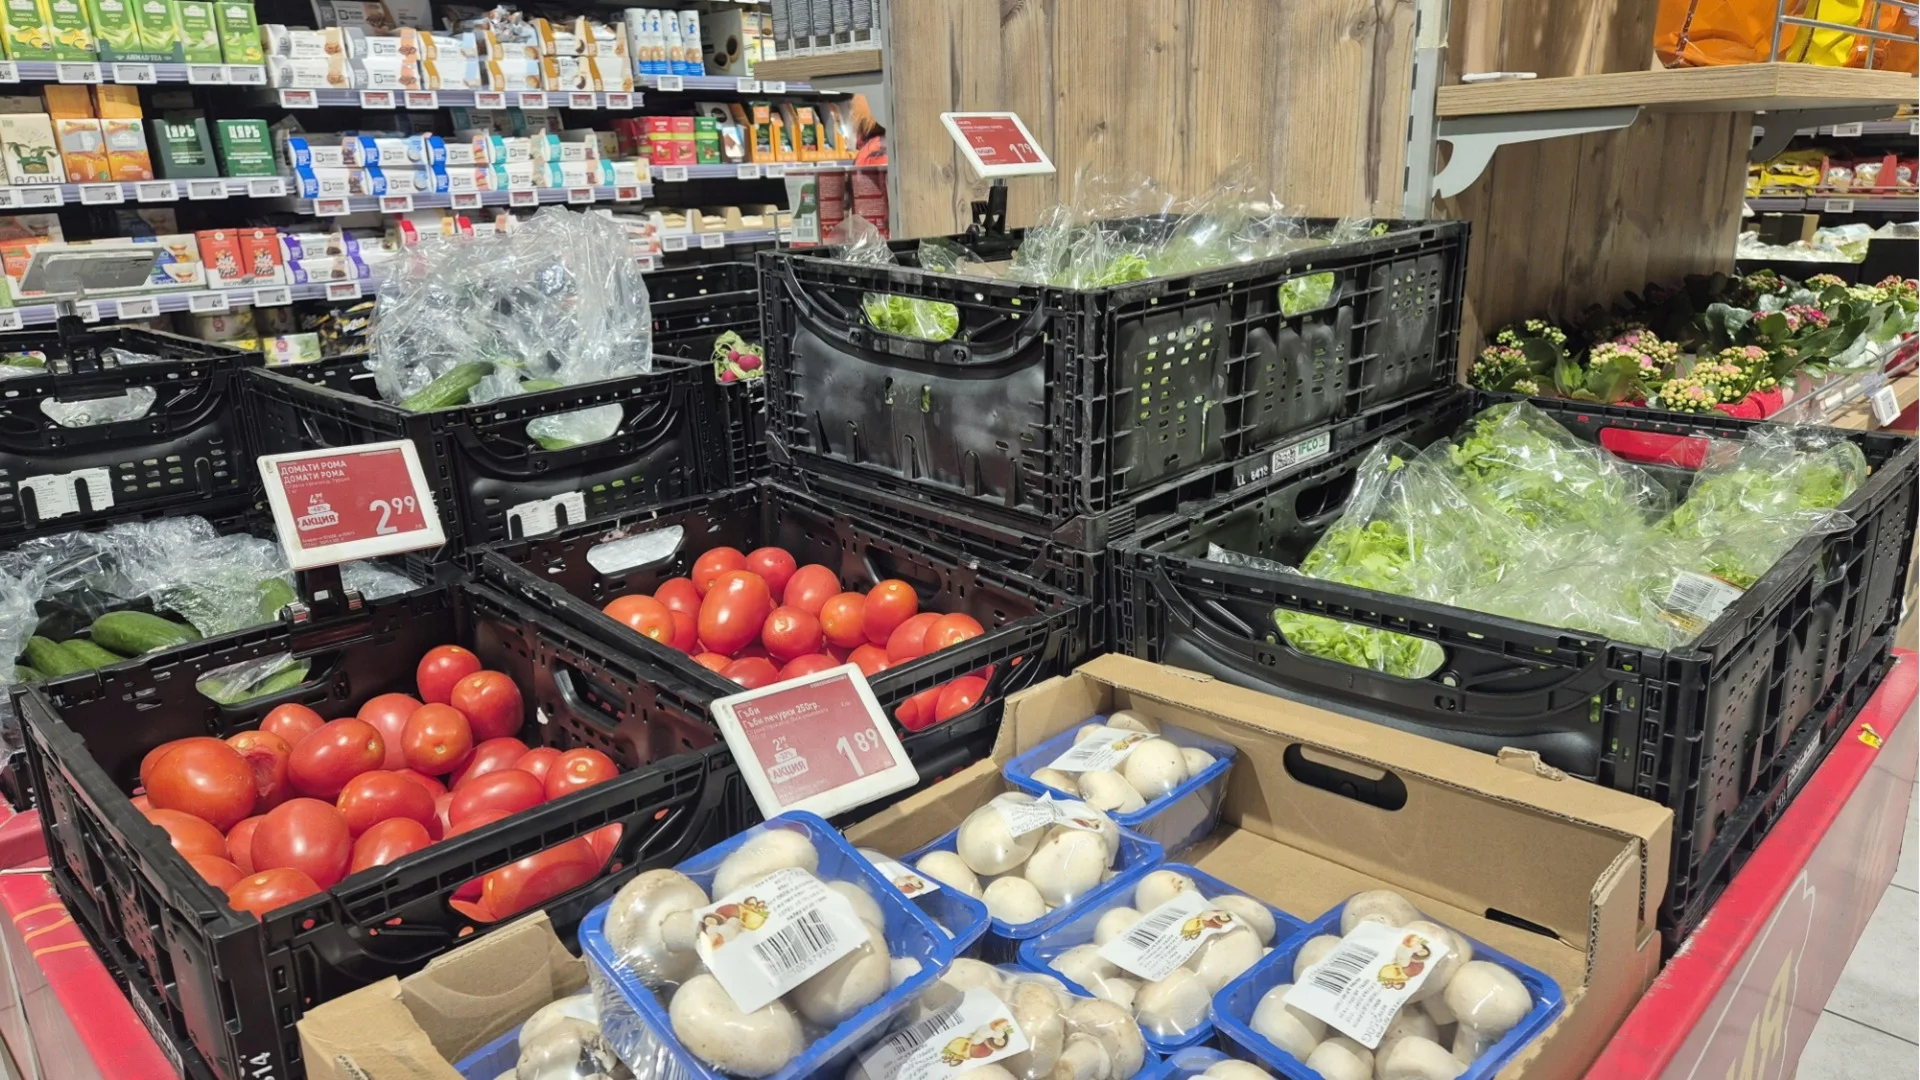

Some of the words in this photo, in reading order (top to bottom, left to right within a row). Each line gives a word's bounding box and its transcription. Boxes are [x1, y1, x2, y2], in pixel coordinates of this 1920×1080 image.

[125, 53, 150, 61] AHMAD
[150, 53, 163, 61] TEA
[1298, 438, 1319, 454] IFCO
[280, 463, 320, 477] ДОМАТИ
[320, 460, 347, 471] РОМА
[283, 472, 319, 485] ДОМАТИ
[320, 469, 345, 479] РОМА
[301, 514, 336, 528] АКЦИЯ
[737, 706, 761, 720] Гъби
[742, 717, 763, 729] Гъби
[764, 710, 796, 723] печурки
[773, 760, 807, 780] АКЦИЯ
